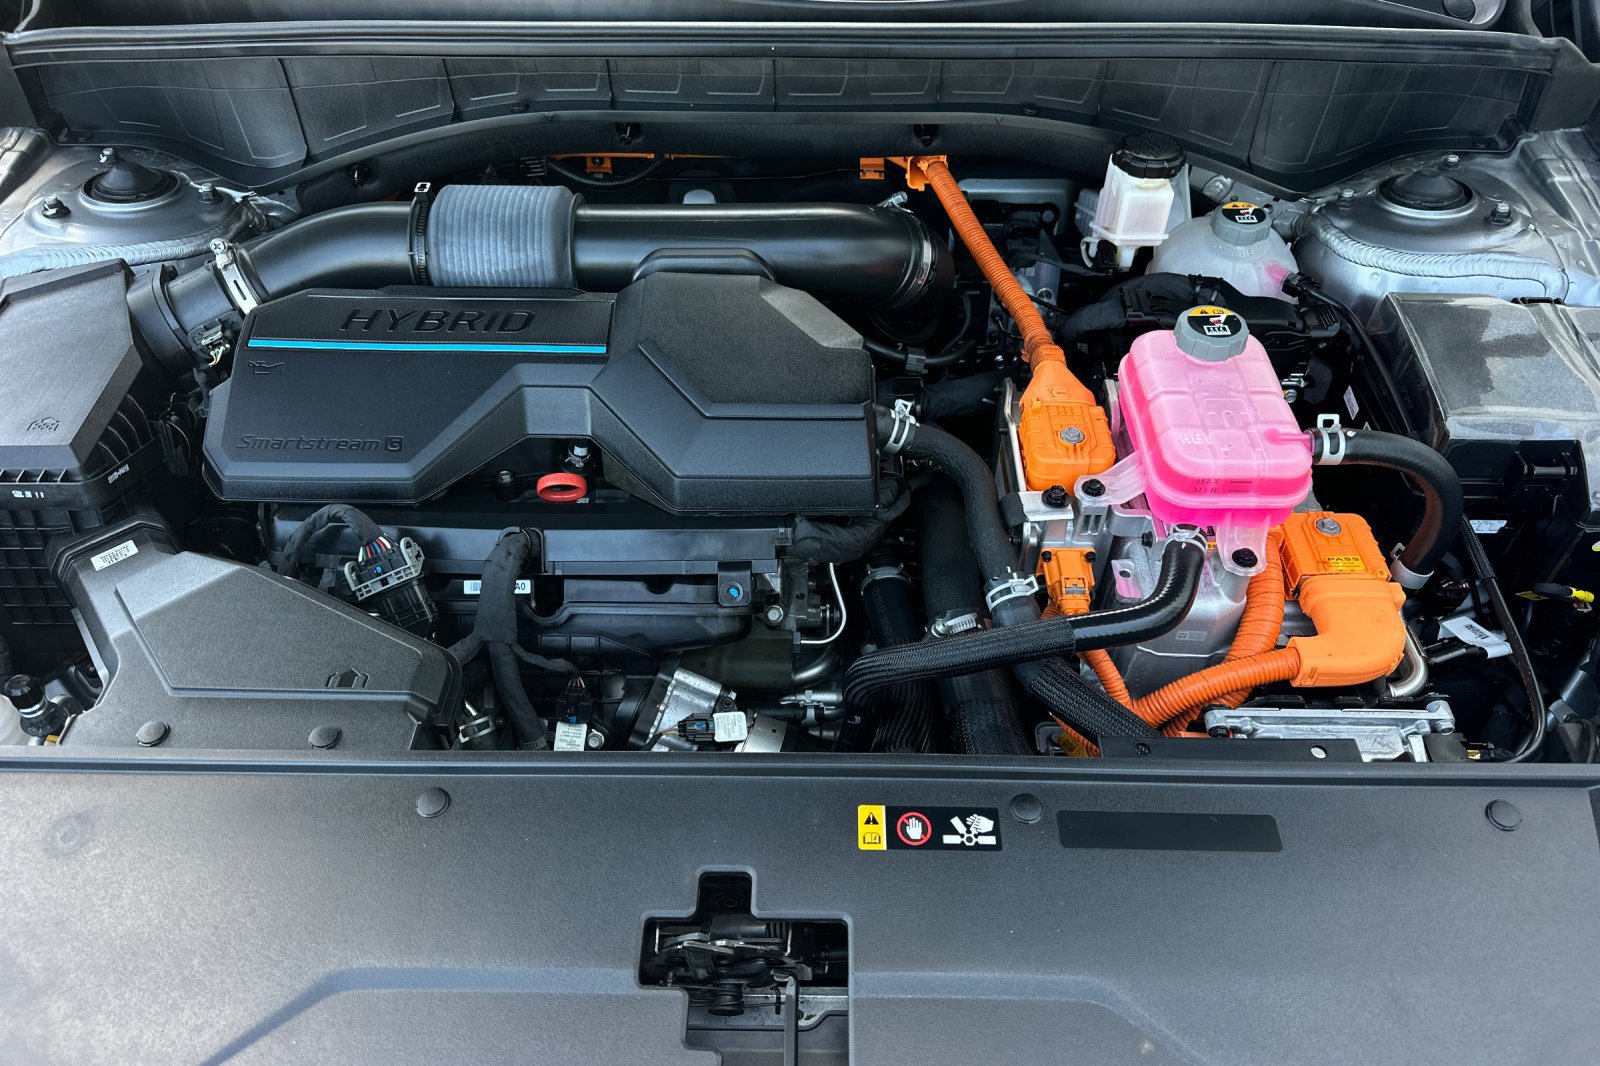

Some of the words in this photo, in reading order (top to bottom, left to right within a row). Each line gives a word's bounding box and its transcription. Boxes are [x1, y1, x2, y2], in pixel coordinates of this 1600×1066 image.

[339, 308, 535, 333] HYBRID
[236, 434, 381, 450] Smartstream
[386, 435, 404, 451] G
